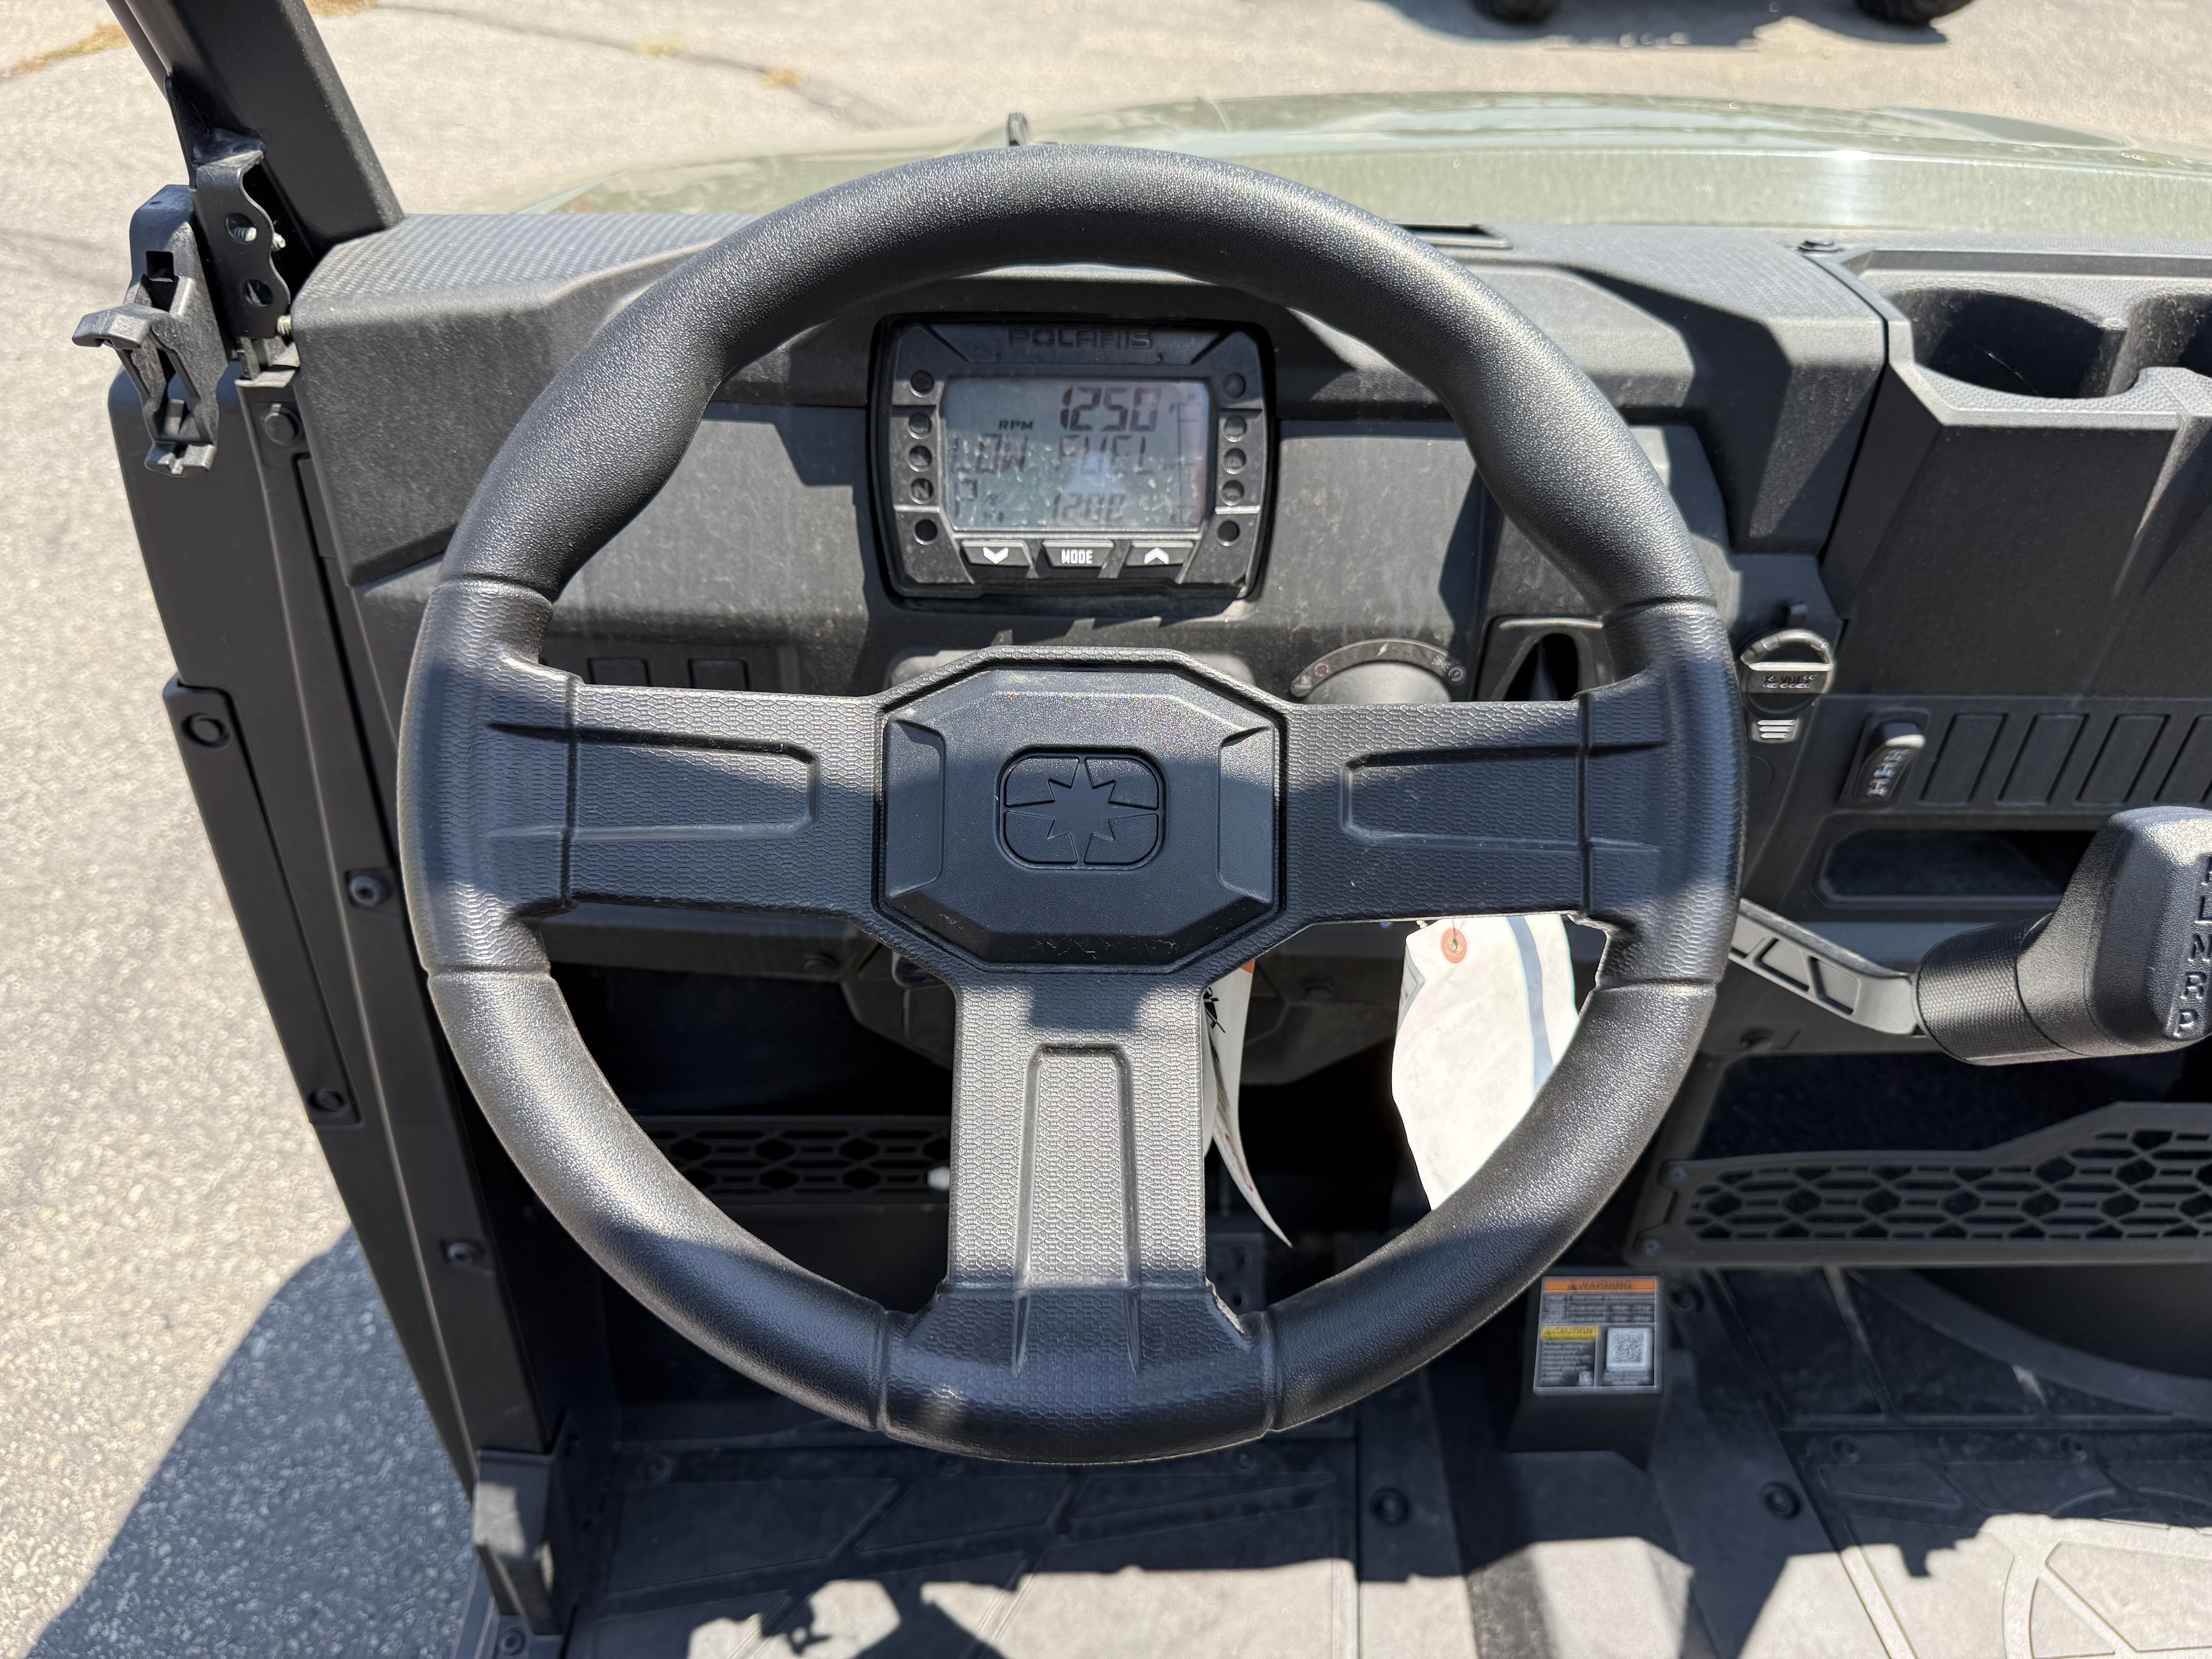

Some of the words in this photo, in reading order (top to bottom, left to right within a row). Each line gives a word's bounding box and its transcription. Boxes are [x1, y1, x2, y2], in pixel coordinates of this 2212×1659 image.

[1009, 328, 1153, 349] POLARIS
[1060, 387, 1160, 432] 1250
[998, 420, 1033, 430] RPM
[1061, 550, 1092, 564] MODE
[2195, 896, 2212, 924] L
[2188, 934, 2212, 962] N
[2180, 972, 2207, 1000] R
[2173, 1009, 2198, 1037] P
[1578, 1280, 1632, 1290] WARNING
